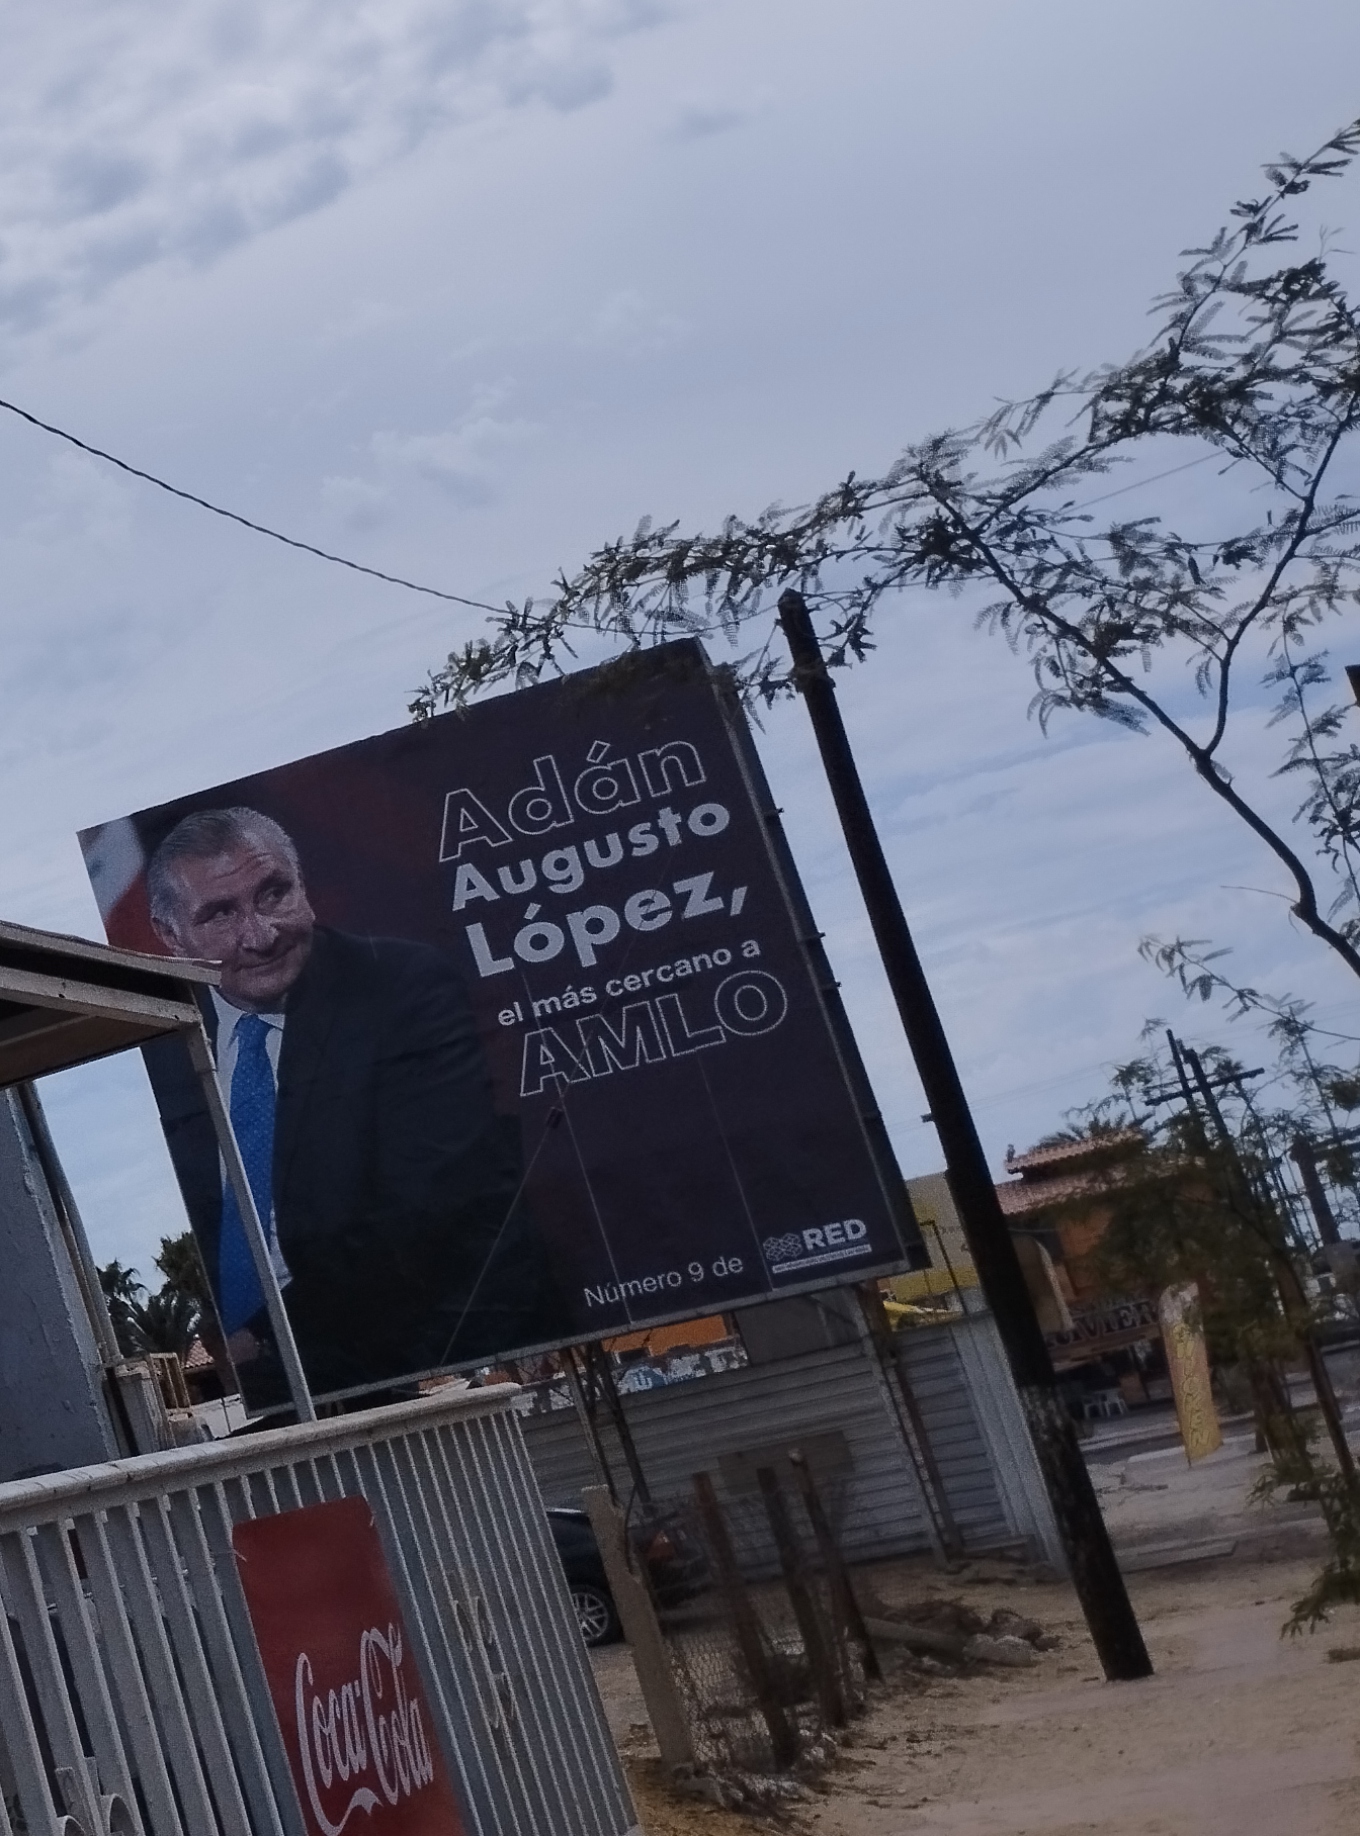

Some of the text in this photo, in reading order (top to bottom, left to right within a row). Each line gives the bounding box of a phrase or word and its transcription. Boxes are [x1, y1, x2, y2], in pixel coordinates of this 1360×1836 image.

[438, 739, 707, 863] Adán
[451, 802, 731, 911] Augusto
[466, 866, 749, 978] López,
[497, 940, 762, 1027] el más cercano a
[519, 969, 788, 1097] AMLO
[584, 1266, 683, 1308] Número
[688, 1261, 705, 1284] 9
[711, 1253, 745, 1279] de
[802, 1219, 867, 1251] RED
[295, 1622, 434, 1836] Coca-Cola
